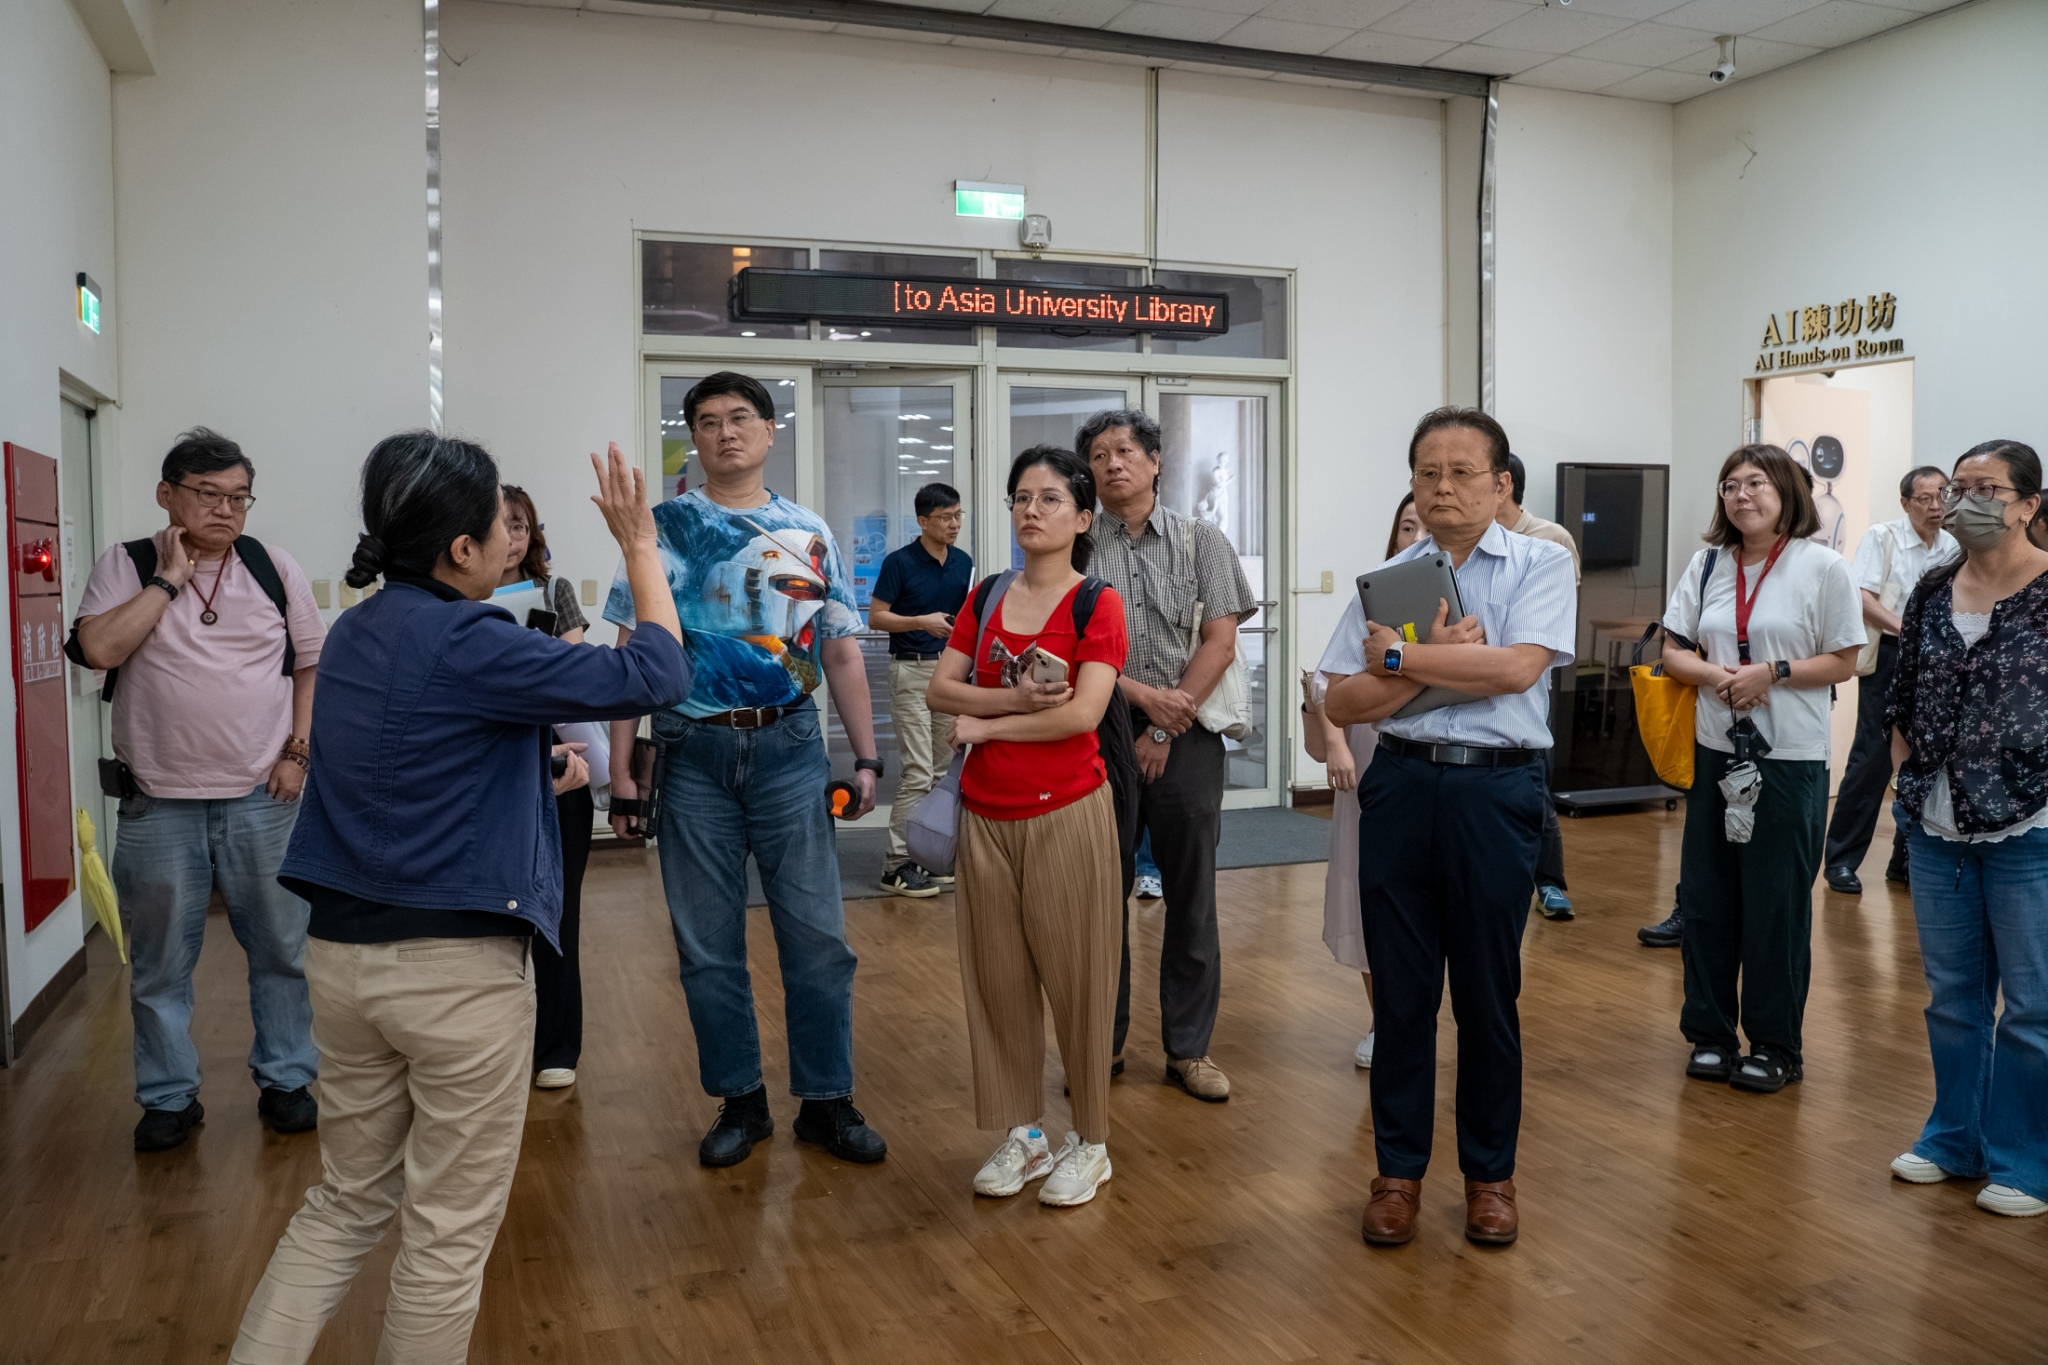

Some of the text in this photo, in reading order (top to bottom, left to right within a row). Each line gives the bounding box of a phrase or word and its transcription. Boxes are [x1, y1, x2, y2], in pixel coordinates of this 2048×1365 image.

[904, 283, 1216, 327] to Asia University Library
[1755, 338, 1904, 372] AI Hands-on Room
